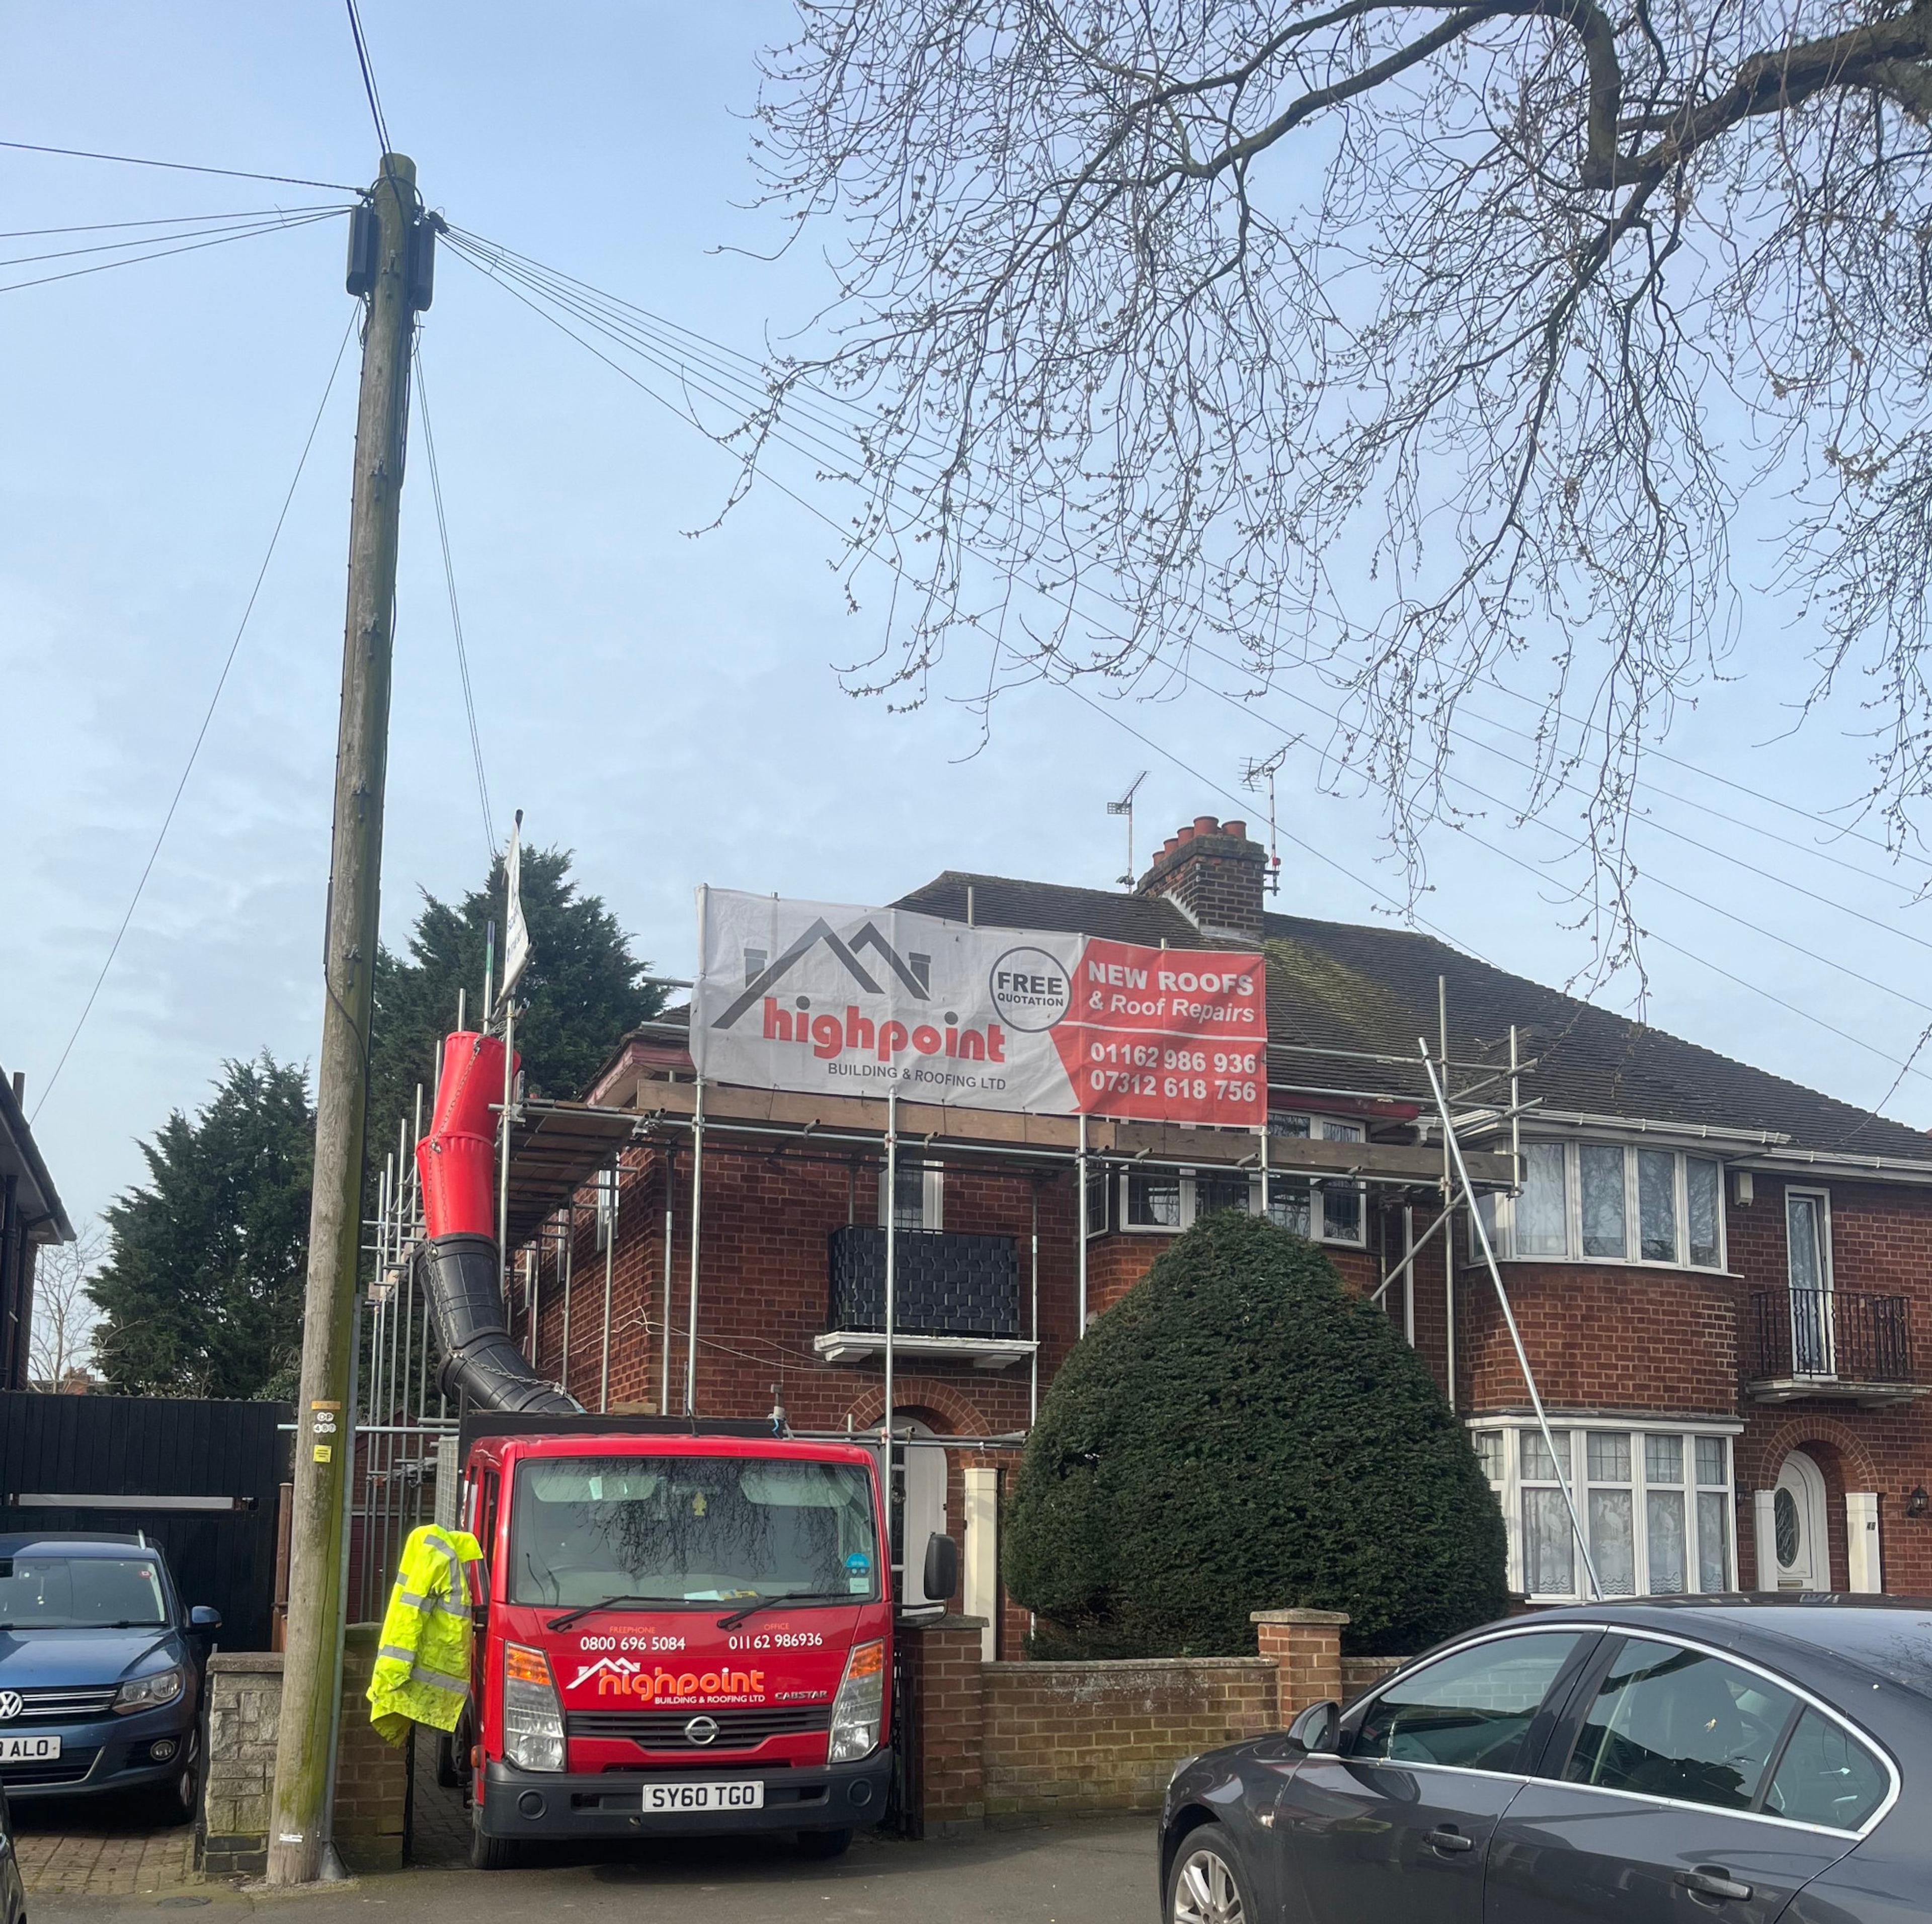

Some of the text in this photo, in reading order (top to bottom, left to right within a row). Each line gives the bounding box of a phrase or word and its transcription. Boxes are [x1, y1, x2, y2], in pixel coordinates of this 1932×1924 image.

[998, 972, 1063, 995] FREE
[1089, 961, 1253, 996] NEW ROOFS
[998, 993, 1064, 1006] QUOTATION
[1089, 990, 1254, 1024] & Roof Repairs
[763, 995, 1005, 1062] highpoint
[1091, 1042, 1256, 1074] 01162 986 936
[828, 1063, 1006, 1090] BUILDING & ROOFING LTD
[1091, 1070, 1256, 1102] 07312 618 756
[580, 1636, 686, 1650] 0800 696 5084
[774, 1633, 823, 1647] 986936
[599, 1666, 765, 1701] highpoint
[775, 1690, 828, 1700] CABSTAR
[655, 1696, 697, 1704] BUILDING
[707, 1695, 747, 1703] ROOFING
[749, 1694, 765, 1702] LTD
[10, 1739, 48, 1757] ALO
[653, 1786, 754, 1807] SY60 TGO
